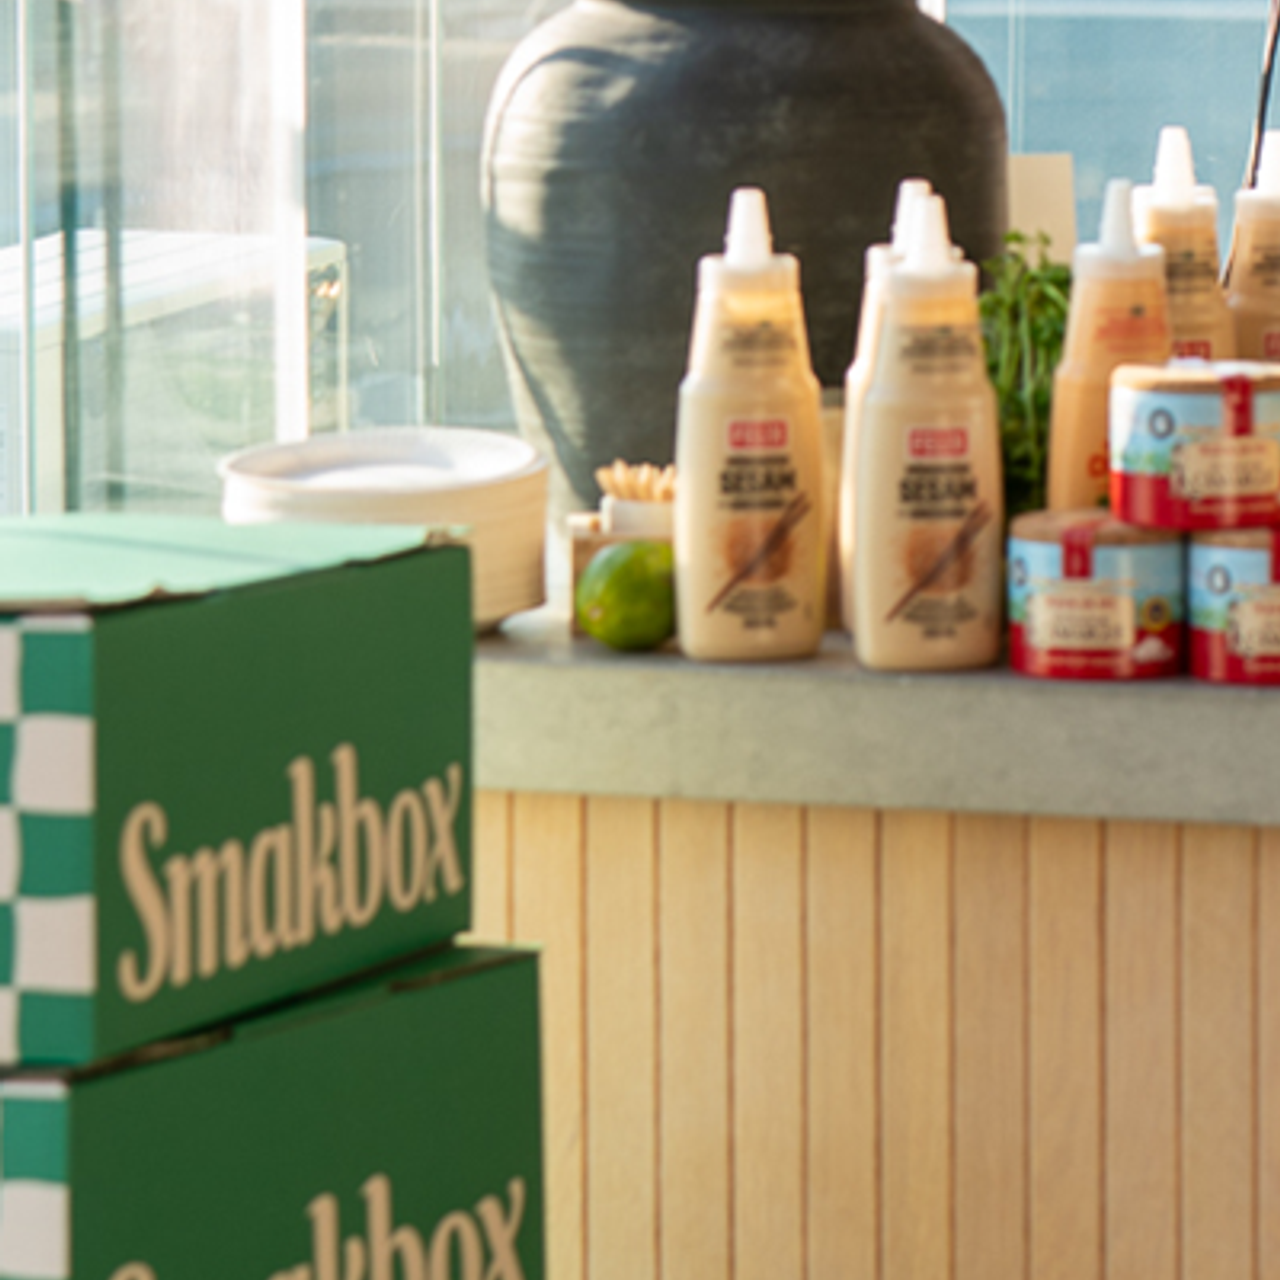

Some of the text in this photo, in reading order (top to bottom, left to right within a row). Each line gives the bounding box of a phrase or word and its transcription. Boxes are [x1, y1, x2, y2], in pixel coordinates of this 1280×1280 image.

[720, 469, 797, 494] SESAM
[899, 478, 978, 503] SESAM
[118, 743, 464, 1002] Smakbox
